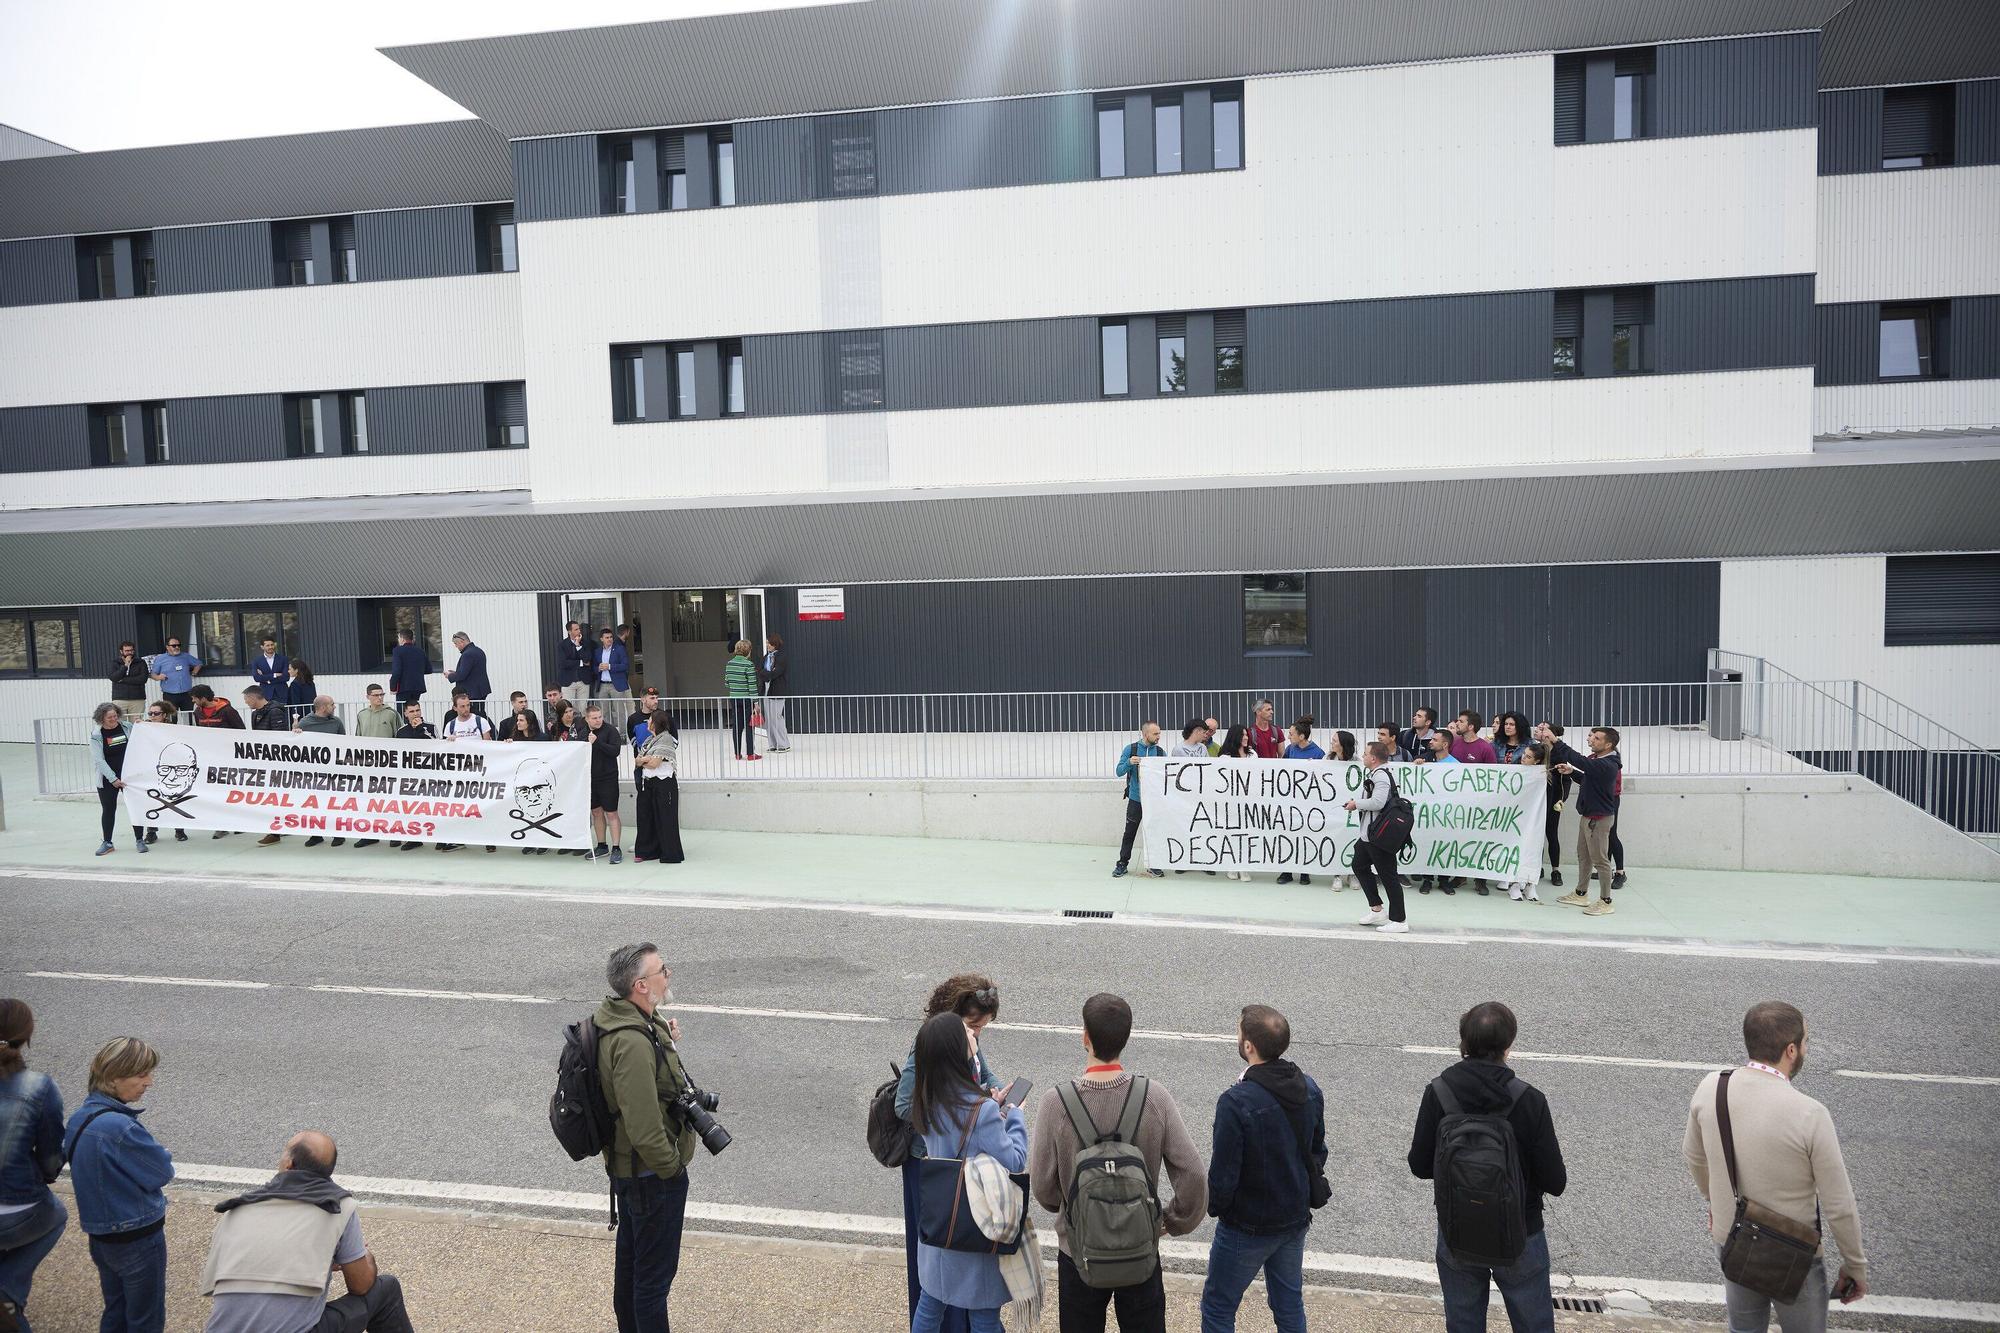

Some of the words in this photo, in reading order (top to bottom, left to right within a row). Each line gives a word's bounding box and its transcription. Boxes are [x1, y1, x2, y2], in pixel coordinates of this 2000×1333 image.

[234, 741, 332, 765] NAFARROAKO
[335, 747, 398, 769] LANBIDE
[402, 750, 487, 777] HEZIKETAN,
[207, 766, 267, 788] BERTZE
[269, 769, 364, 793] MURRIZKETA
[367, 775, 397, 795] BAT
[399, 778, 454, 798] EZARRI
[453, 780, 507, 800] DIGUTE
[1164, 763, 1212, 796] FCT
[1215, 767, 1251, 797] SIN
[1261, 768, 1337, 802] HORAS
[1442, 766, 1523, 796] GABEKO
[226, 790, 295, 807] DUAL
[301, 794, 319, 809] A
[327, 796, 358, 811] LA
[366, 798, 483, 819] NAVARRA
[1190, 801, 1326, 833] ALUMNADO
[1411, 801, 1524, 836] ARRAIPENIK
[270, 813, 327, 831] ¿SIN
[335, 817, 436, 837] HORAS?
[1167, 833, 1336, 868] DESATENDIDO
[1427, 840, 1521, 876] IKASLEGOA
